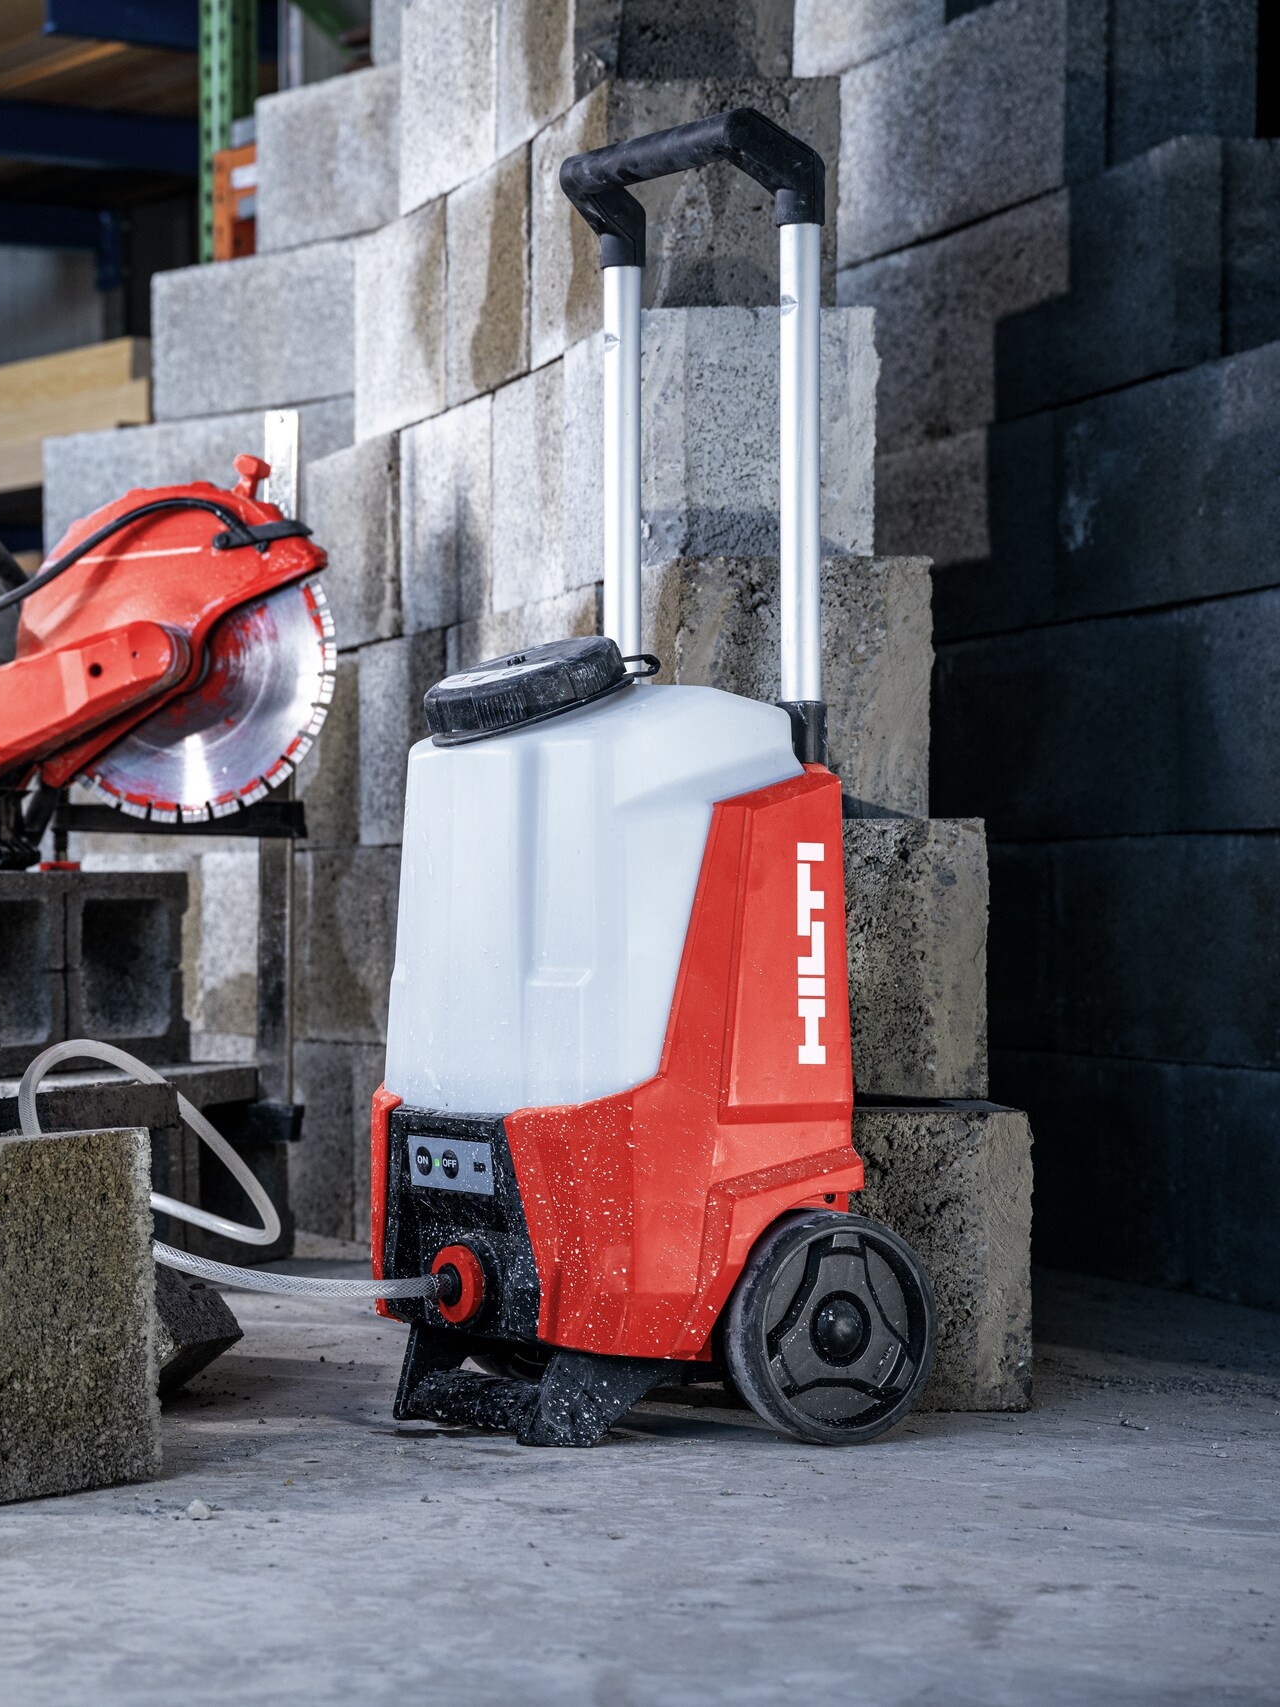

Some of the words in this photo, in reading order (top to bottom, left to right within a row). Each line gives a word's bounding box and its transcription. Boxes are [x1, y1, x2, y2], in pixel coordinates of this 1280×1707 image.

[797, 842, 826, 1065] HILTI
[417, 1155, 429, 1165] ON
[442, 1158, 457, 1168] OFF
